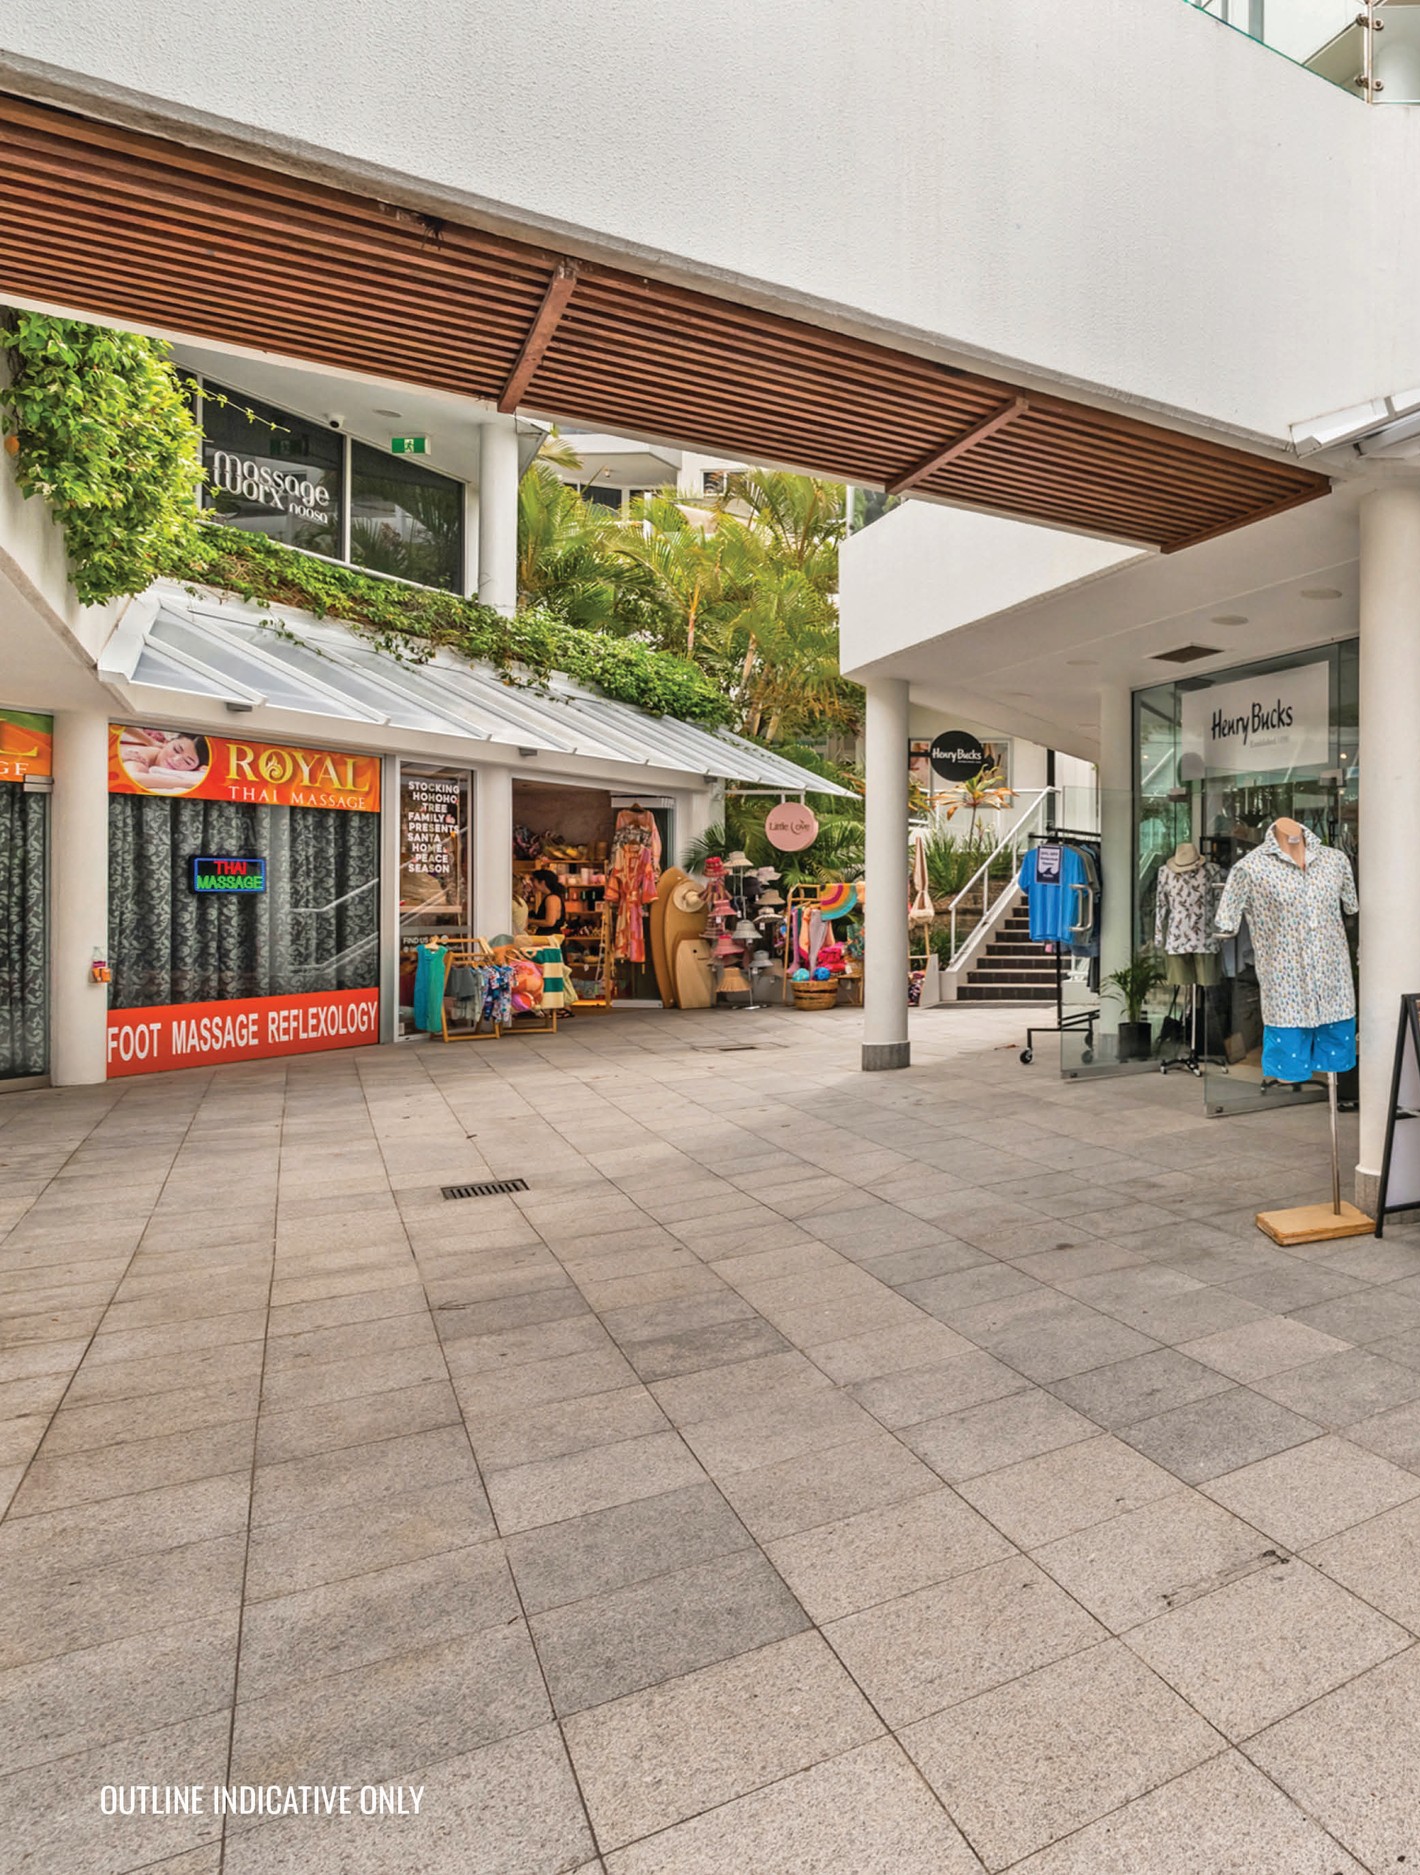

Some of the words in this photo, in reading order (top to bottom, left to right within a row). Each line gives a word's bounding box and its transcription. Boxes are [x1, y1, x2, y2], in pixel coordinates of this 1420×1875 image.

[213, 451, 330, 507] massage
[213, 469, 284, 511] worx
[289, 503, 328, 524] noosa
[1211, 708, 1249, 746] Henry
[1251, 698, 1293, 734] Bucks
[932, 747, 956, 763] Henry
[957, 748, 981, 760] Bucks
[225, 743, 370, 792] ROYAL
[408, 781, 460, 794] STOCKING
[228, 785, 278, 802] THAI
[290, 792, 366, 810] MASSAGE
[412, 792, 457, 804] HOHOHO
[422, 803, 448, 813] TREE
[408, 812, 445, 823] FAMILY
[408, 822, 460, 833] PRESENTS
[407, 832, 441, 842] SANTA
[412, 843, 443, 853] HOME
[415, 853, 449, 863] PEACE
[214, 860, 247, 875] THAI
[408, 863, 450, 873] SEASON
[196, 875, 263, 889] MASSAGE
[107, 1023, 162, 1063] FOOT
[172, 1013, 259, 1055] MASSAGE
[267, 1001, 378, 1044] REFLEXOLOGY
